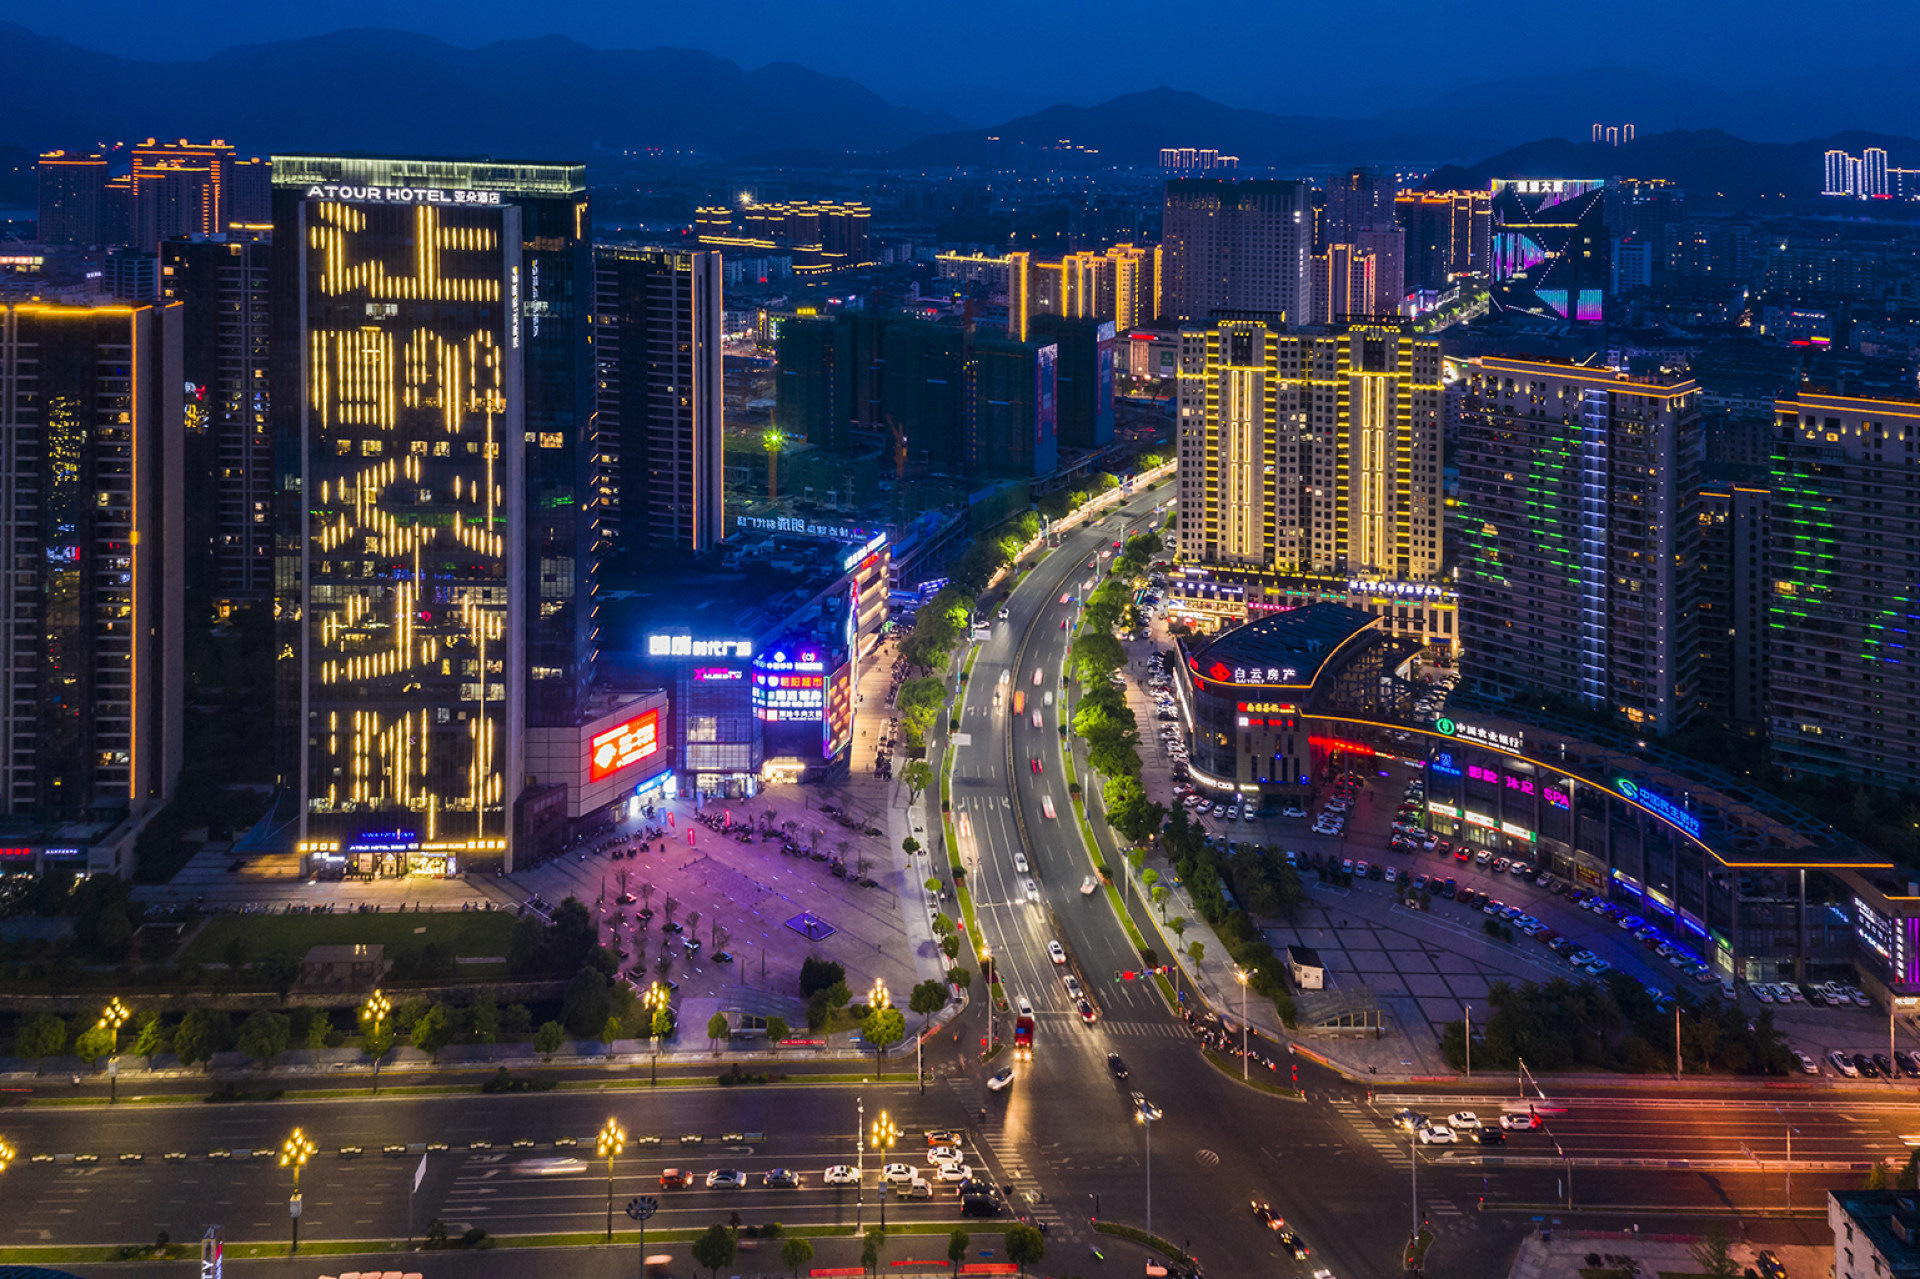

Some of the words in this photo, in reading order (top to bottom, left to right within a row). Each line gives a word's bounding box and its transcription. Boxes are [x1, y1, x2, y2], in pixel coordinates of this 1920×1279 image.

[308, 185, 381, 200] ATOUR
[386, 188, 451, 202] HOTEL
[454, 190, 501, 204] 亚朵酒店
[1235, 667, 1295, 681] 白云房产
[1456, 722, 1520, 748] 中国农业银行
[1505, 776, 1535, 796] 沐足
[1543, 787, 1570, 807] SPA
[1640, 788, 1700, 831] 中国民生银行
